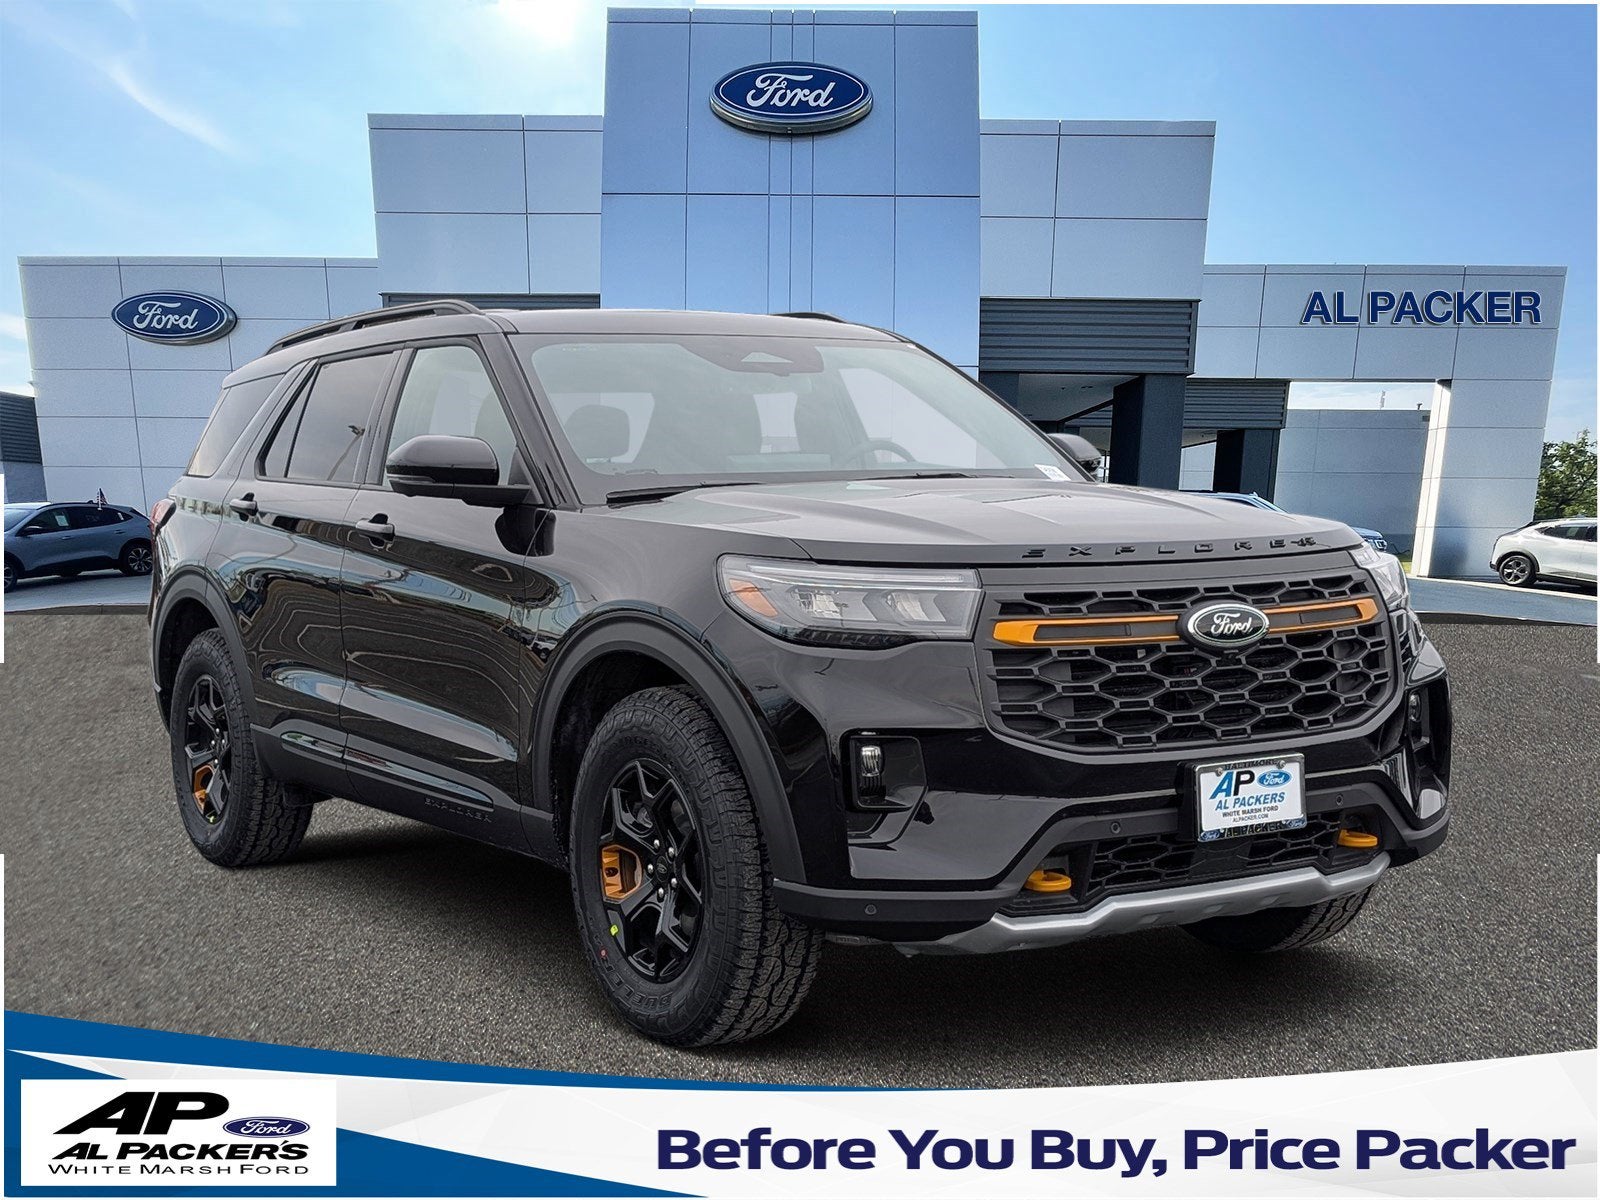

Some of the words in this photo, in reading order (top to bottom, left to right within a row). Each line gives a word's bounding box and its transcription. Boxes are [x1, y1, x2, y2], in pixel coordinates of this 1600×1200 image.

[746, 73, 836, 107] Ford
[133, 301, 199, 329] Ford
[1301, 290, 1360, 325] AL
[1368, 289, 1542, 325] PACKER
[1021, 536, 1318, 560] EXPLORER
[1211, 612, 1253, 636] Ford
[1209, 770, 1255, 799] AP
[1263, 771, 1286, 785] Ford
[1215, 799, 1230, 811] AL
[1233, 791, 1286, 809] PACKERS
[1223, 810, 1240, 818] WHITE
[1242, 807, 1262, 815] MARSH
[1263, 805, 1279, 813] FORD
[1232, 813, 1269, 823] ALPACKER.COM
